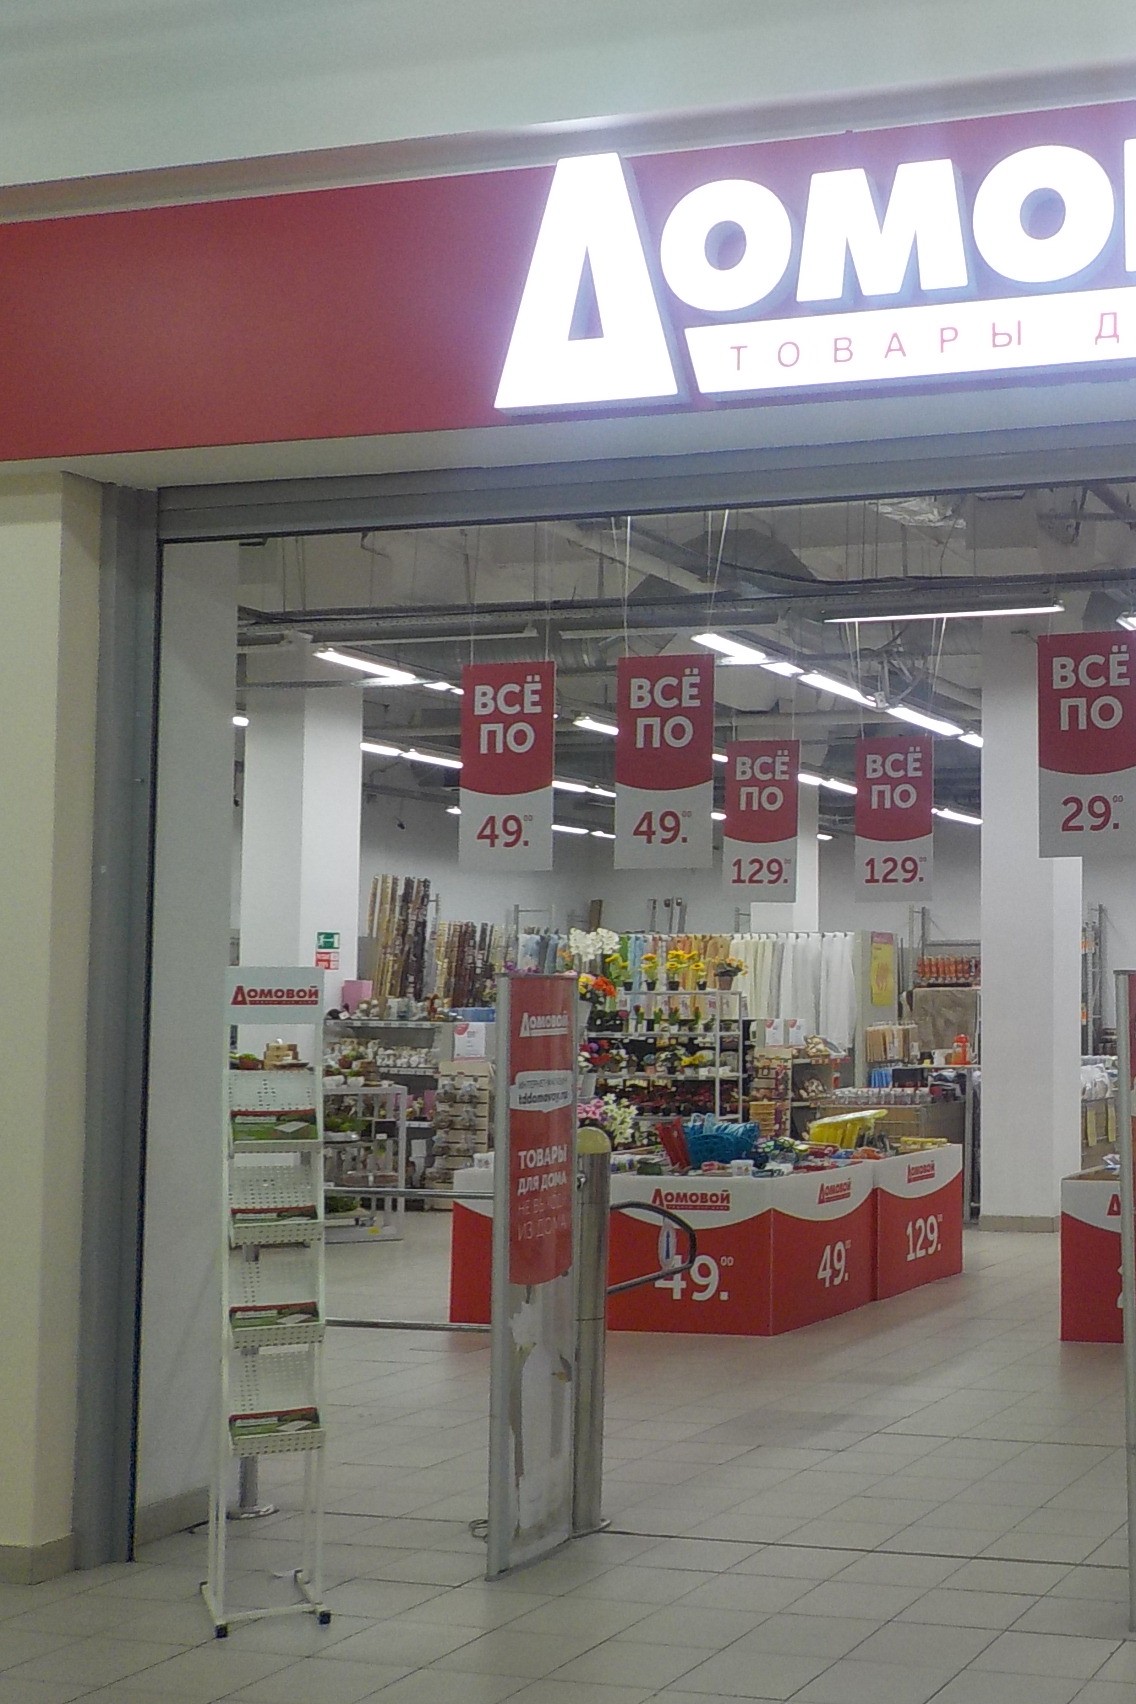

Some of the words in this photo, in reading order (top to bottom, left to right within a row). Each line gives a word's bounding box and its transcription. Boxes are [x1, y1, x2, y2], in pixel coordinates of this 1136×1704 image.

[729, 319, 1023, 372] ТОВАРЫ
[1052, 645, 1130, 689] ВСЁ
[473, 674, 543, 716] ВСЁ
[630, 667, 701, 709] ВСЁ
[1059, 695, 1124, 731] ПО
[479, 721, 536, 754] ПО
[635, 715, 694, 749] ПО
[735, 749, 790, 781] ВСЁ
[865, 746, 923, 779] ВСЁ
[740, 786, 784, 811] ПО
[871, 783, 917, 810] ПО
[230, 985, 319, 1006] Домовой
[518, 1144, 568, 1170] ТОВАРЫ
[517, 1175, 540, 1197] ДЛЯ
